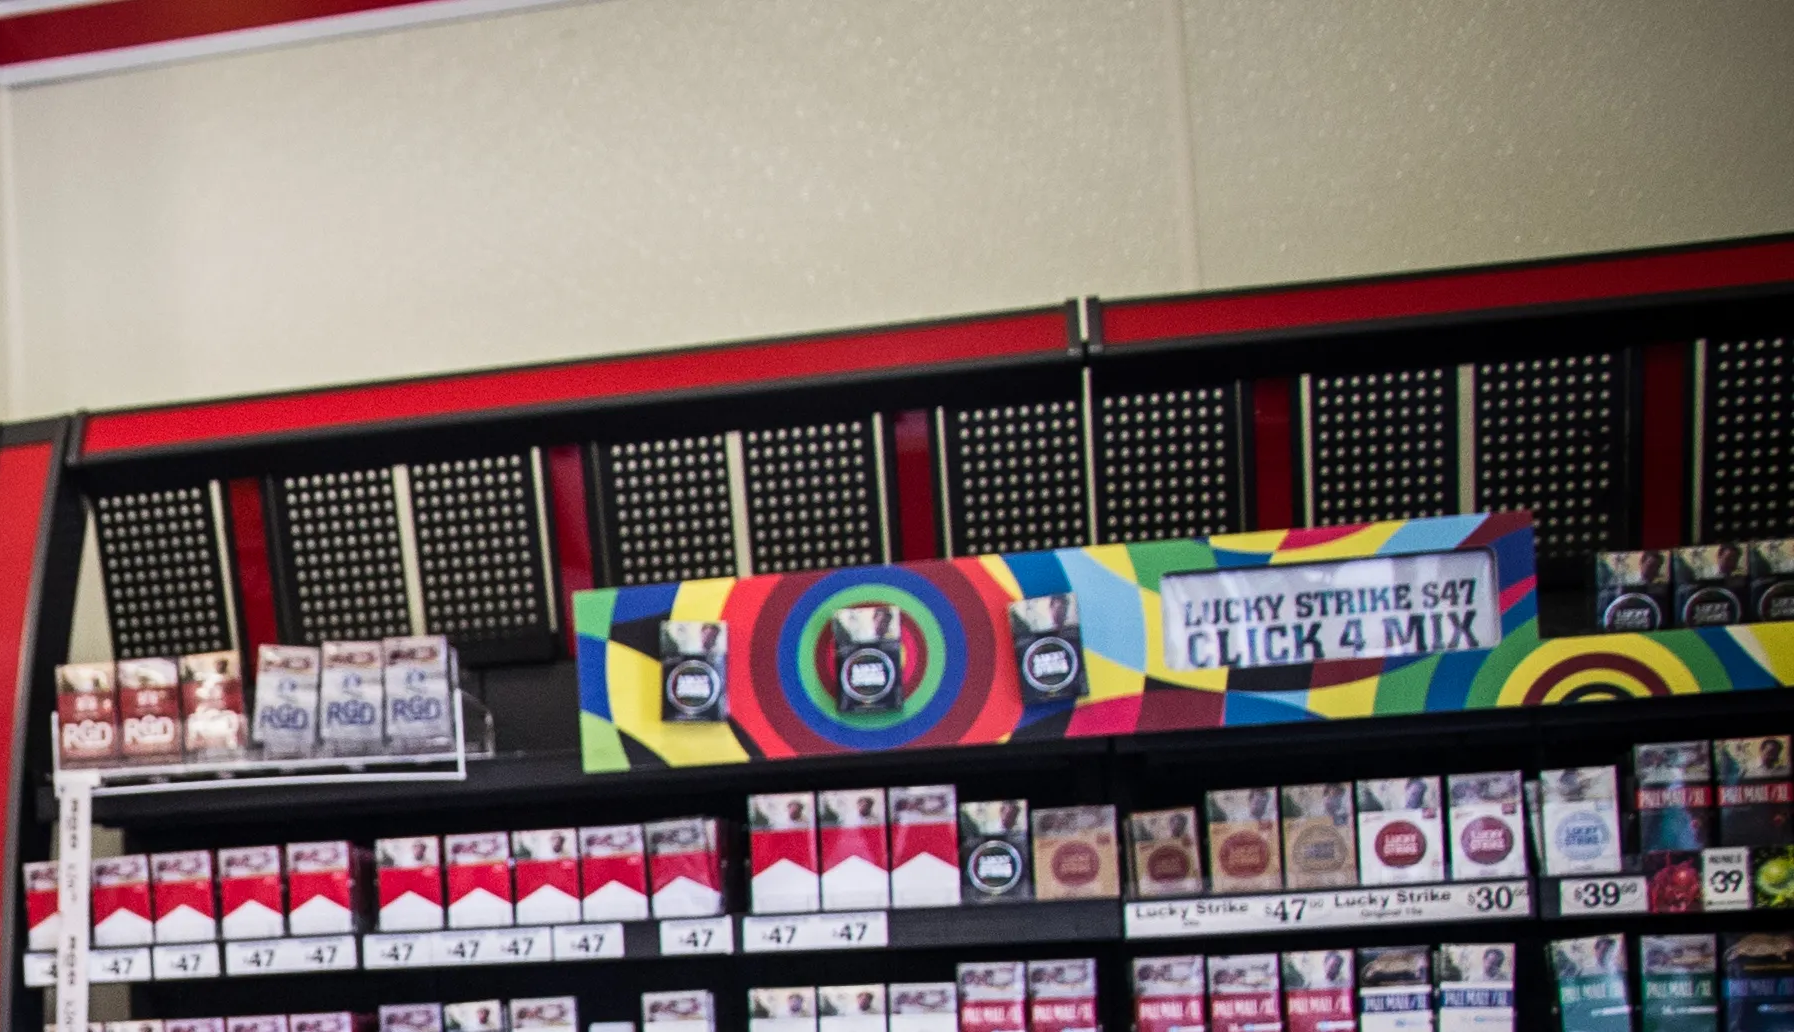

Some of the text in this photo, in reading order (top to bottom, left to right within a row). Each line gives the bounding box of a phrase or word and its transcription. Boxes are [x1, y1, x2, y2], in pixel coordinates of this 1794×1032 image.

[1185, 594, 1283, 627] LUCKY
[1296, 583, 1411, 618] STRIKE
[1188, 609, 1480, 668] CLICK 4 MIX
[1135, 905, 1188, 924] Lucky
[1197, 901, 1248, 917] Strike
[1334, 891, 1388, 910] Lucky
[1397, 889, 1451, 906] Strike
